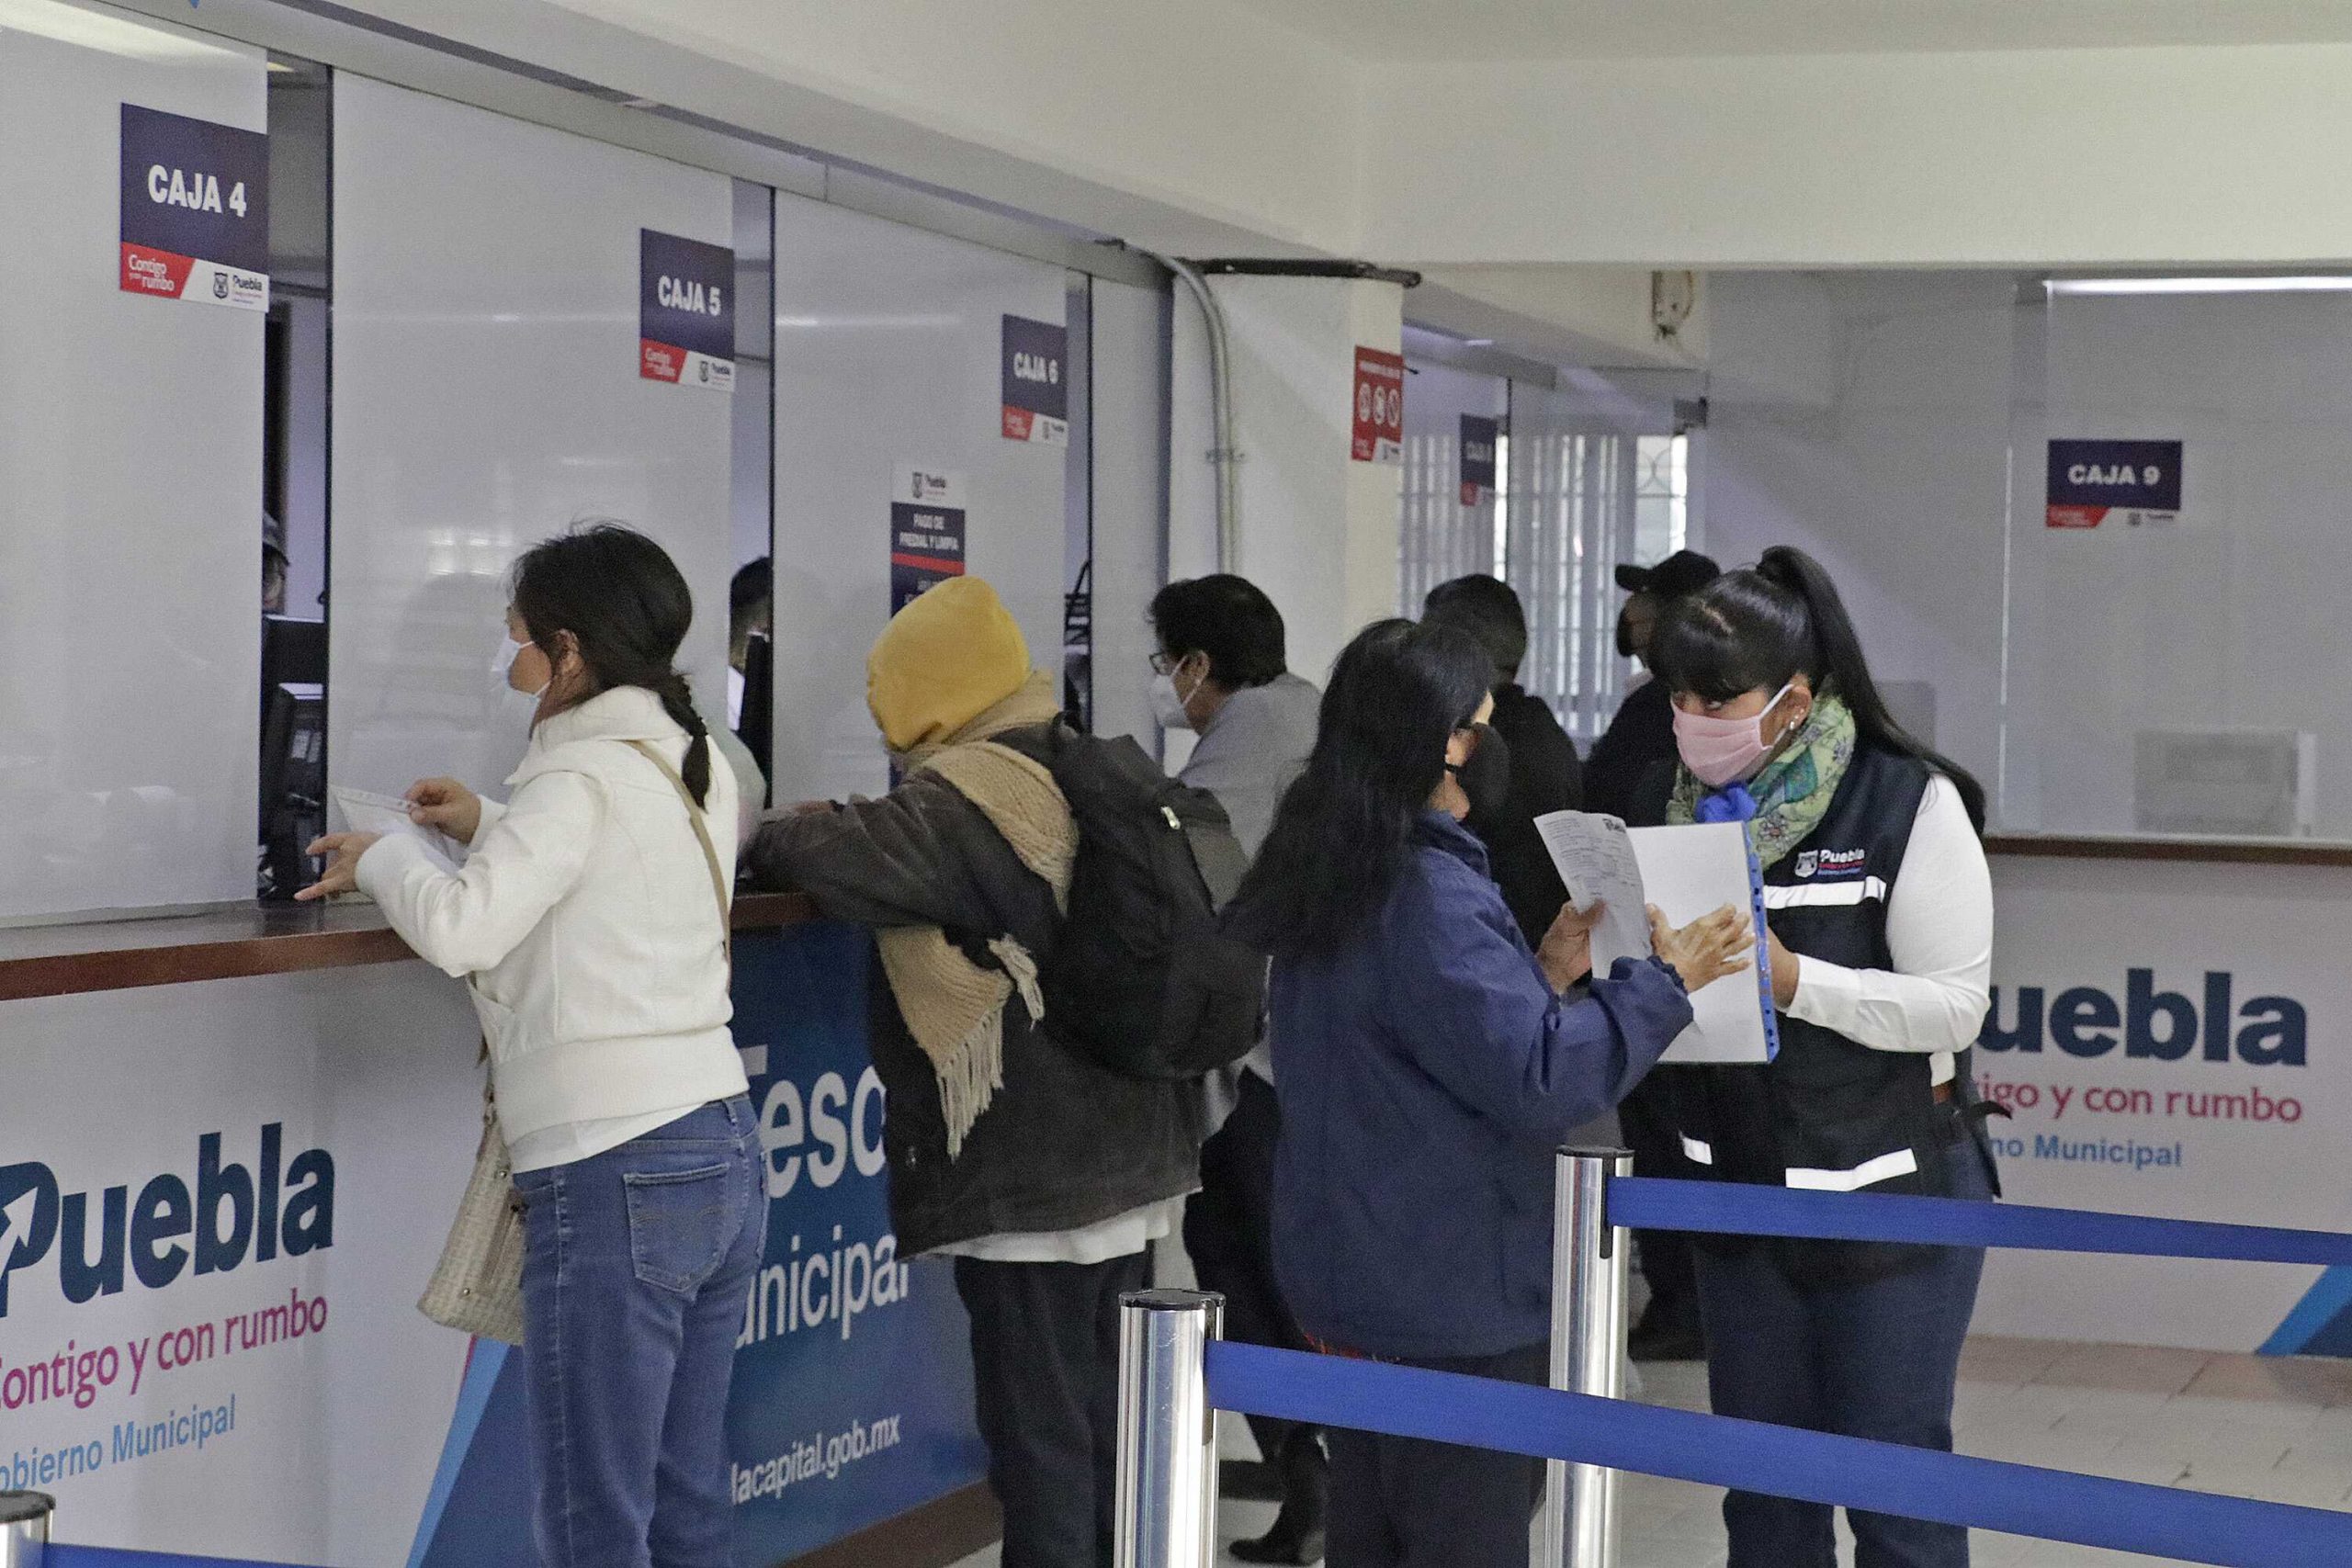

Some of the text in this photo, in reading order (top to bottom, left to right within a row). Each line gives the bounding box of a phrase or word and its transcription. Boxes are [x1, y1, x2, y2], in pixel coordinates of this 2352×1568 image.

[148, 164, 246, 218] CAJA 4
[129, 254, 167, 279] Contigo
[141, 274, 175, 292] rumbo
[232, 275, 263, 292] Puebla
[658, 276, 721, 317] CAJA 5
[1013, 352, 1047, 383] CAJA
[2068, 464, 2161, 486] CAJA 9
[1820, 848, 1865, 863] Puebla
[2050, 1084, 2074, 1120] y
[2084, 1087, 2160, 1114] con
[2165, 1086, 2302, 1124] rumbo
[2035, 1134, 2183, 1170] Municipal
[0, 1122, 335, 1318] Puebla
[0, 1288, 328, 1409] ontigo y con rumbo
[112, 1393, 237, 1464] Municipal
